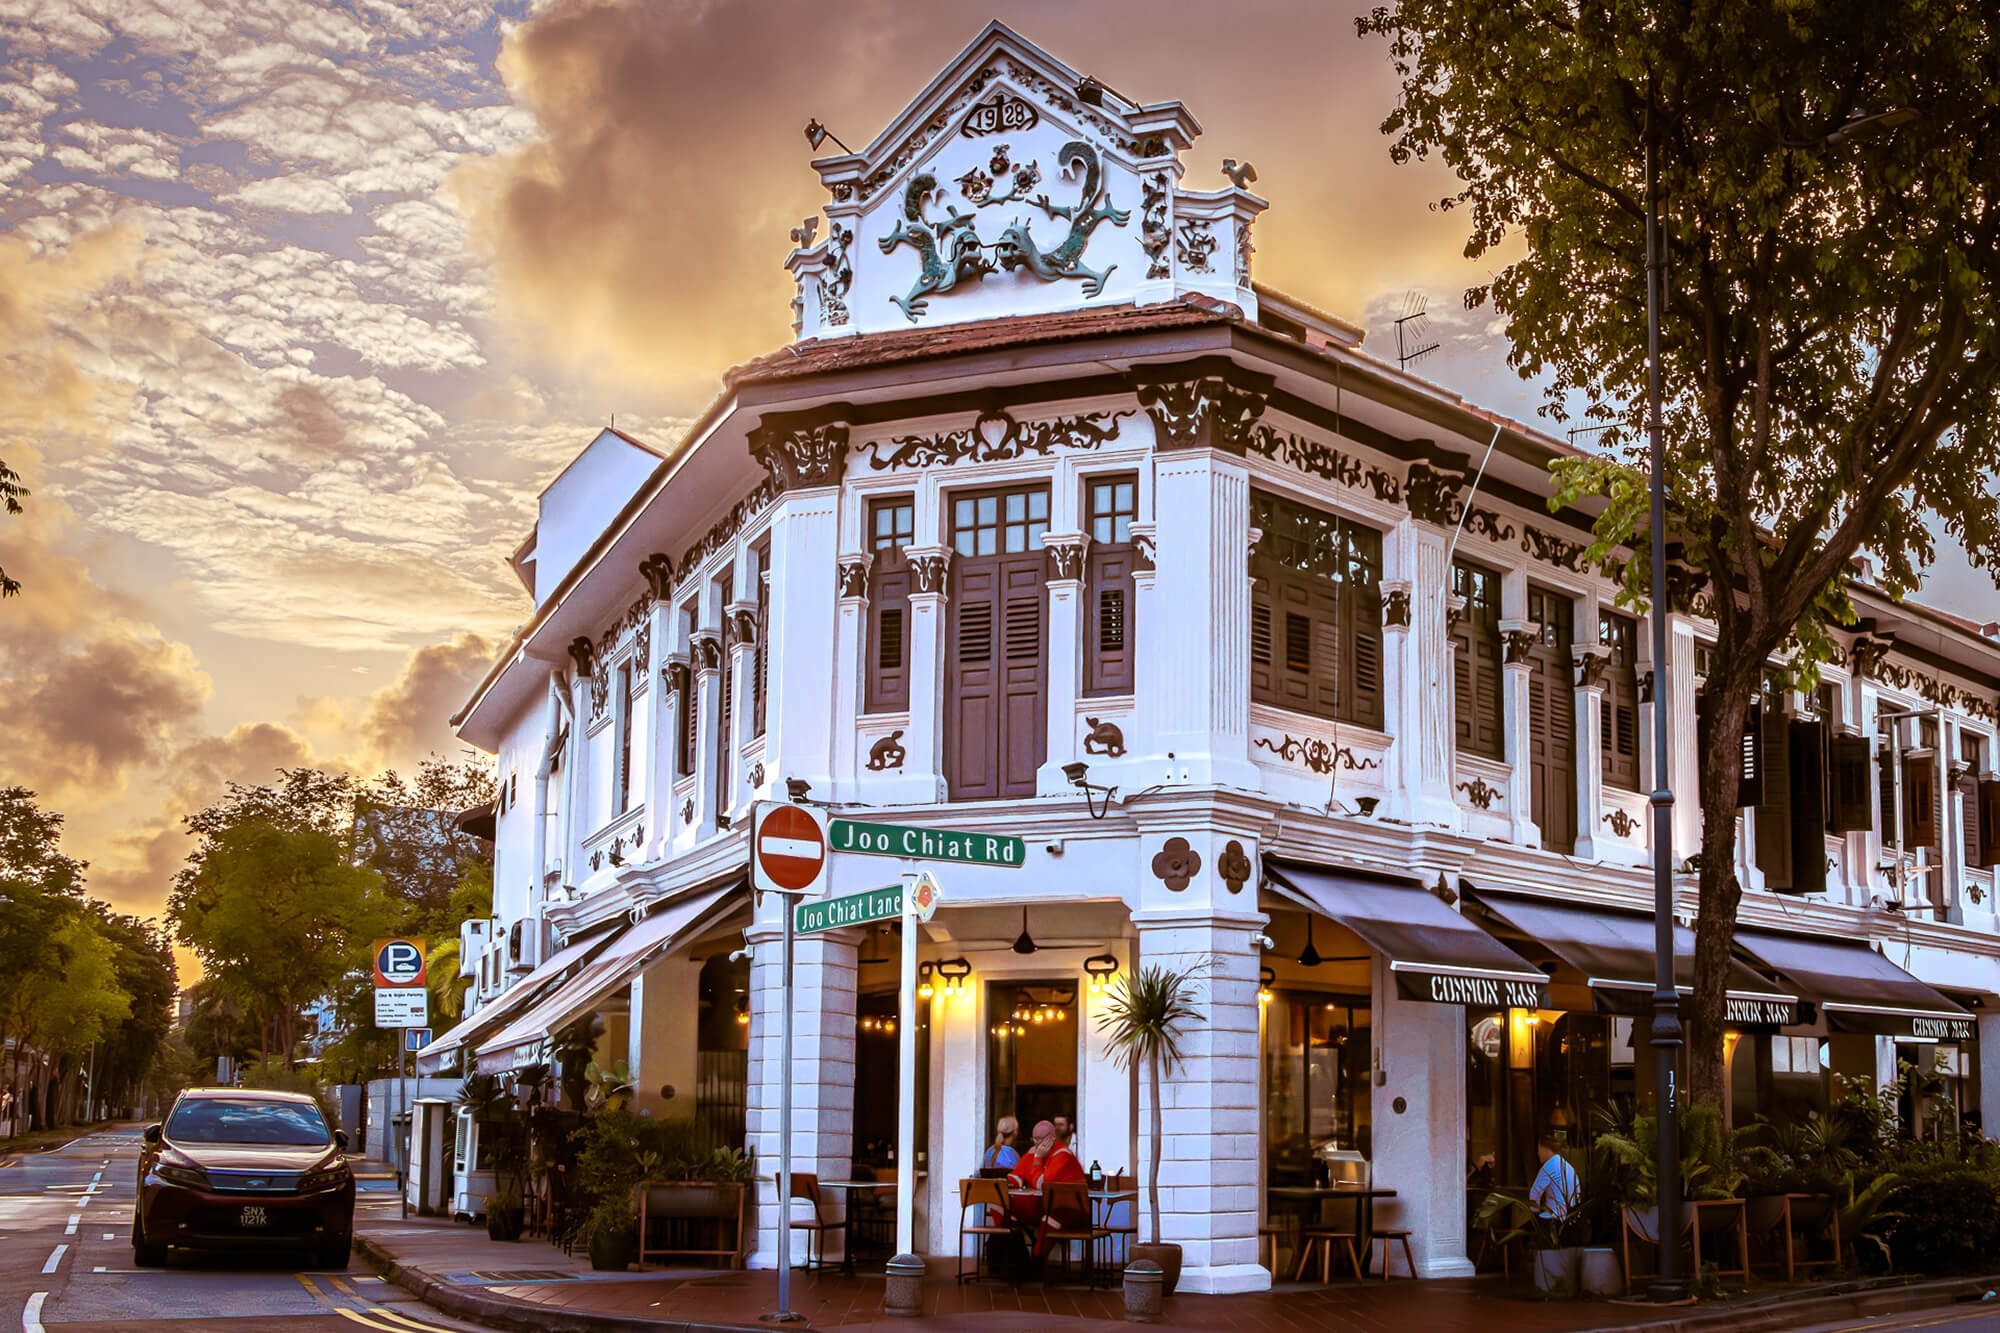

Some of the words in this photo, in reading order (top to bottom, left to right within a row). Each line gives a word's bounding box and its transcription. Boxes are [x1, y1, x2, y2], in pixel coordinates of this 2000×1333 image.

[843, 825, 889, 851] Joo
[903, 830, 973, 859] Chiat
[986, 838, 1014, 862] Rd
[802, 908, 823, 930] Joo
[828, 898, 863, 925] Chiat
[868, 895, 901, 917] Lane
[1431, 975, 1499, 1005] COMMON
[1505, 982, 1538, 1007] MAN
[1913, 1018, 1949, 1038] COMMON
[240, 1215, 268, 1225] 1121K
[243, 1206, 265, 1216] SNX
